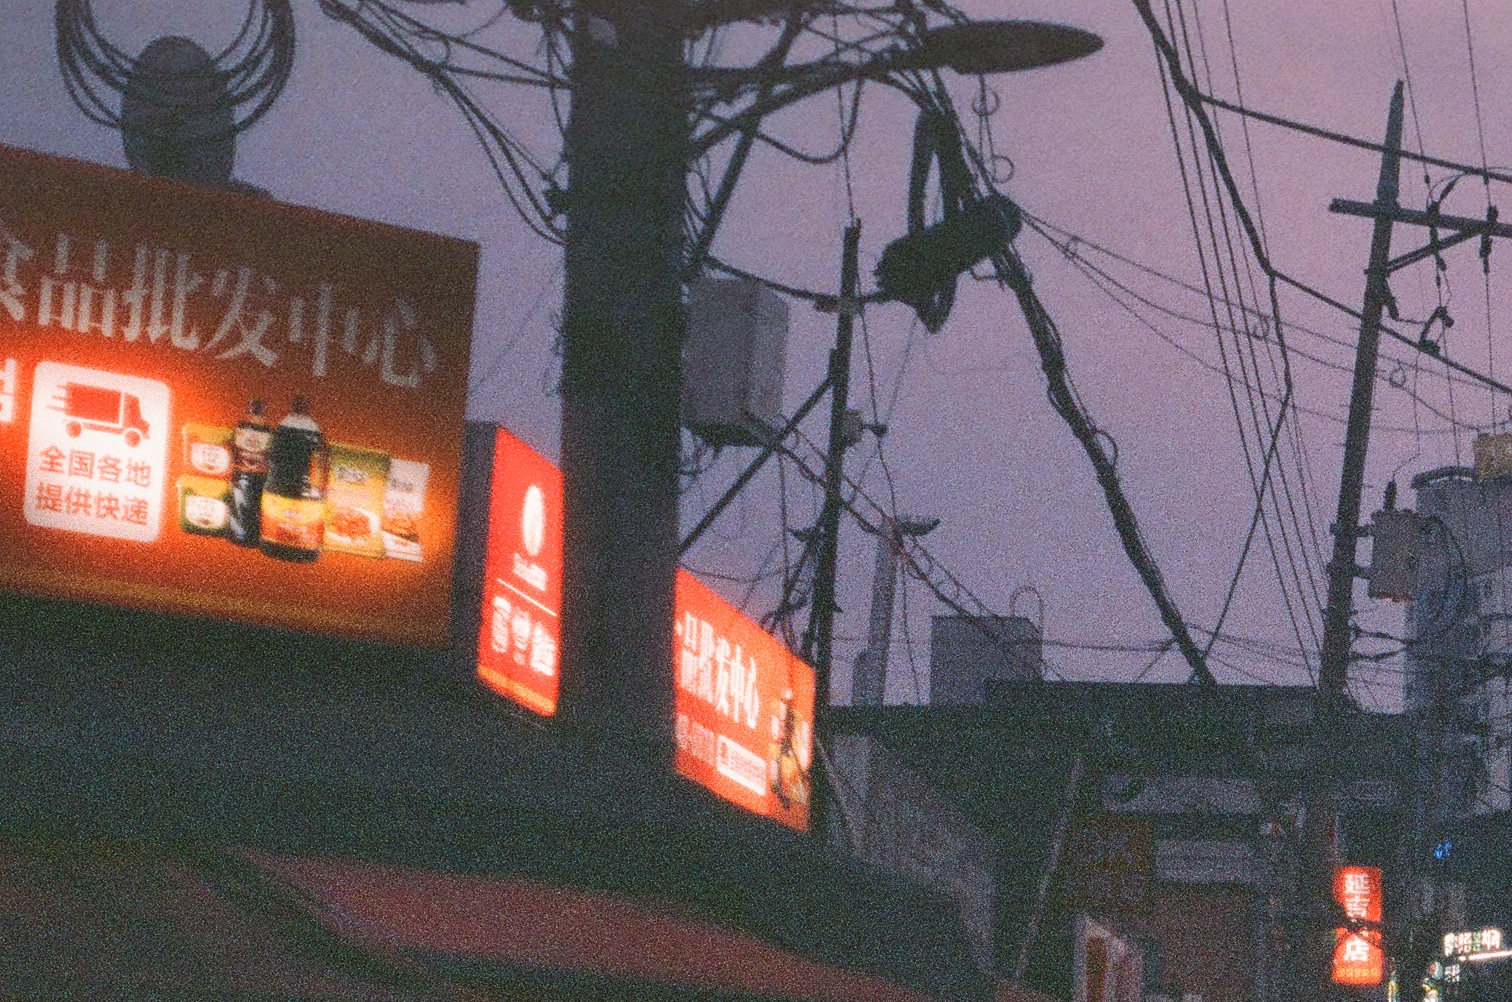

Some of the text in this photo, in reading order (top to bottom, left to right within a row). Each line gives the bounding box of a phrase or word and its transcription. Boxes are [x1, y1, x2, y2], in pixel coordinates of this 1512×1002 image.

[38, 445, 152, 488] 全国各地
[36, 481, 150, 527] 提供快递
